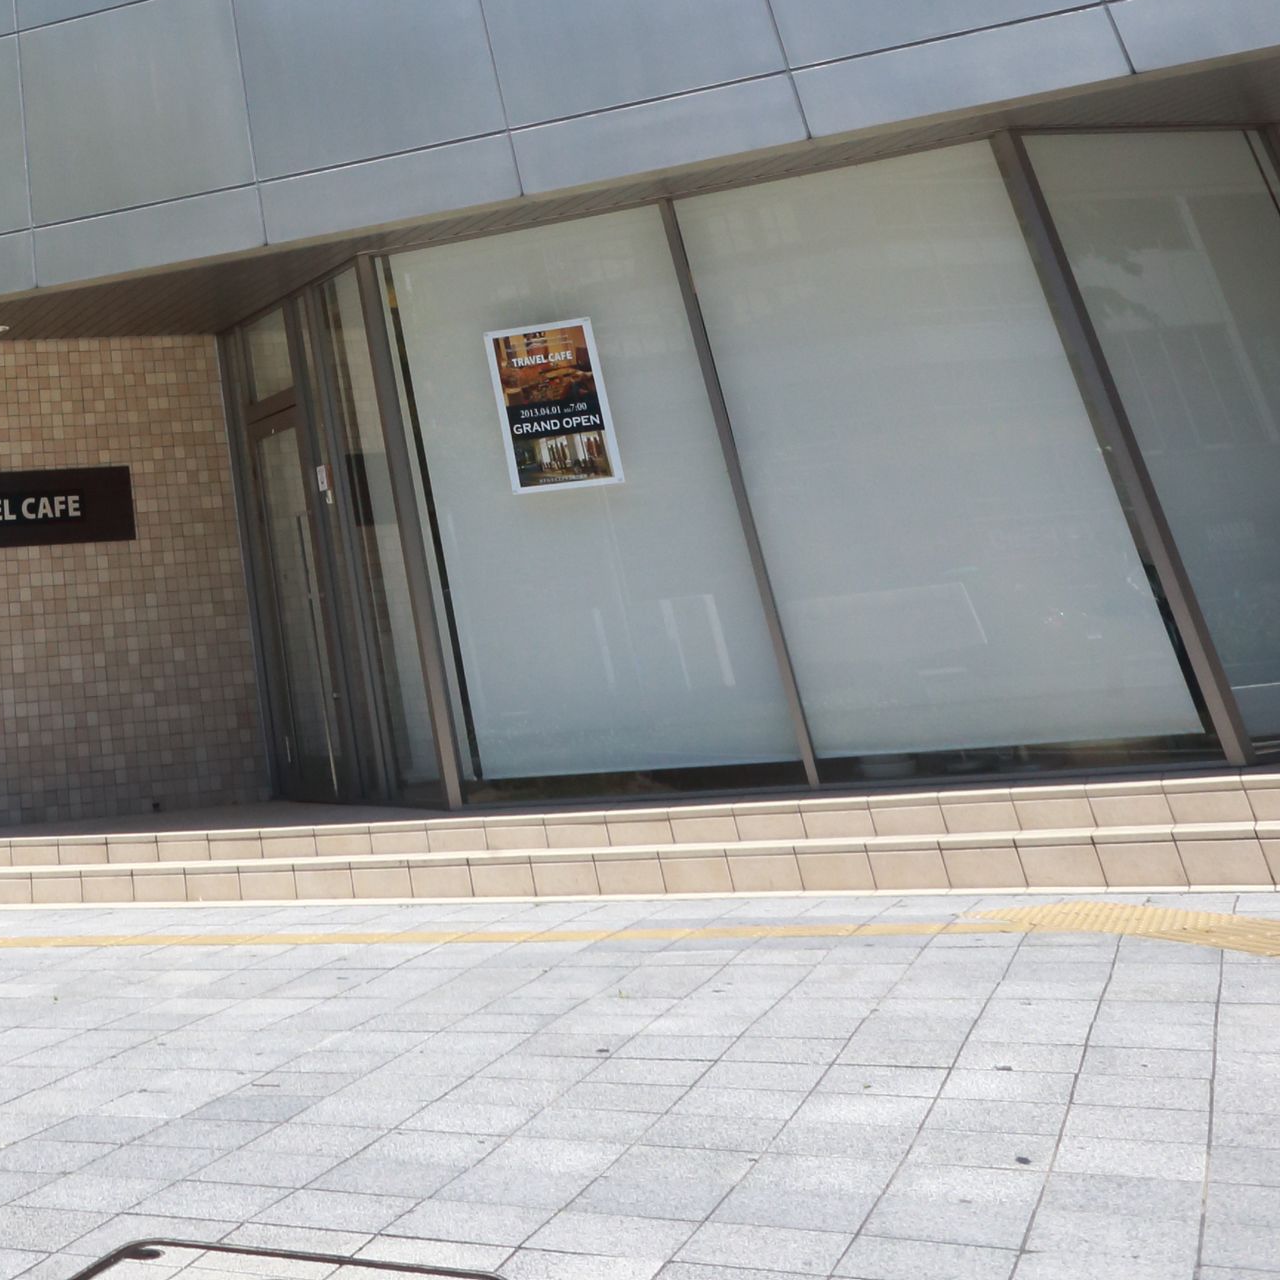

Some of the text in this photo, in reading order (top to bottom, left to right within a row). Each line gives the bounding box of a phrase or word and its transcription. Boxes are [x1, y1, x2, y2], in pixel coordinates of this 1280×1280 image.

[512, 350, 573, 368] TRAVEL CAFE
[520, 406, 561, 419] 2013.04.01
[513, 414, 600, 435] GRAND OPEN
[21, 495, 81, 520] CAFE
